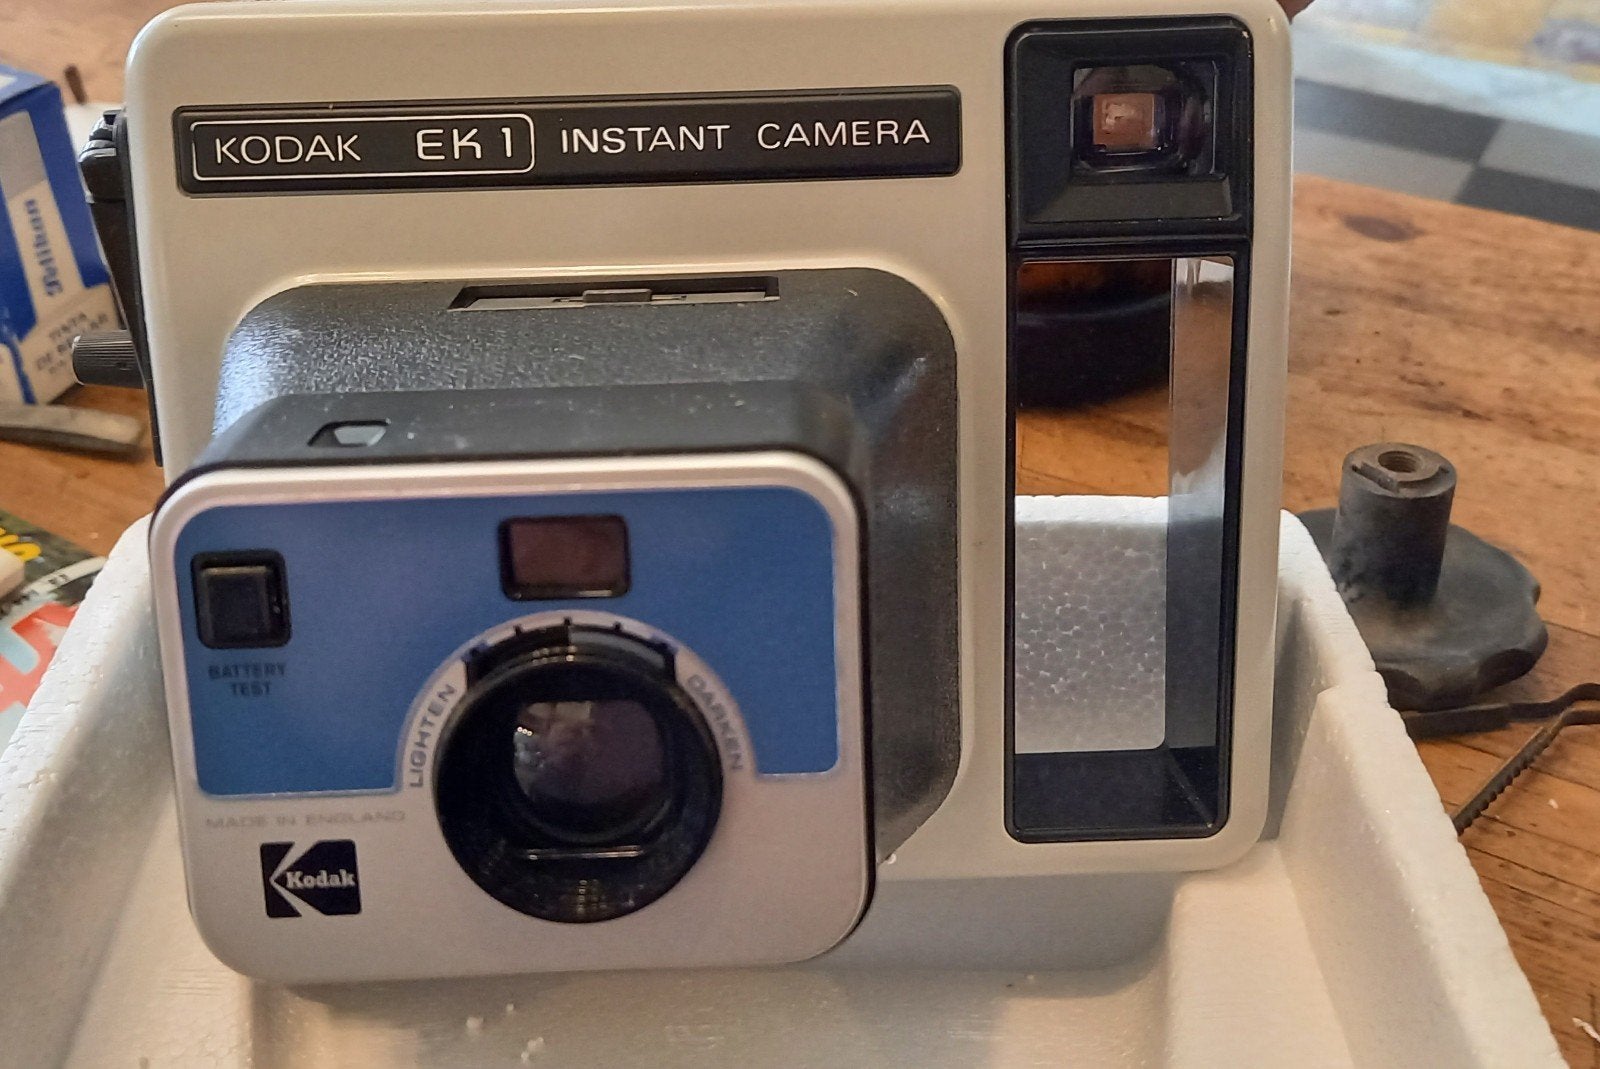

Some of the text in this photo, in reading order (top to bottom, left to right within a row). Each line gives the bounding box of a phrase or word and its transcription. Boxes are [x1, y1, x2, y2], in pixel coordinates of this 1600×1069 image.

[214, 127, 512, 165] KODAK EK 1
[561, 119, 931, 154] INSTANT CAMERA
[208, 662, 287, 680] BATTERY
[231, 682, 272, 696] TEST
[409, 683, 457, 788] LIGHTEN
[687, 673, 744, 772] DARKEN
[206, 810, 406, 828] MADE IN ENGLAND
[284, 868, 356, 890] Kodak
